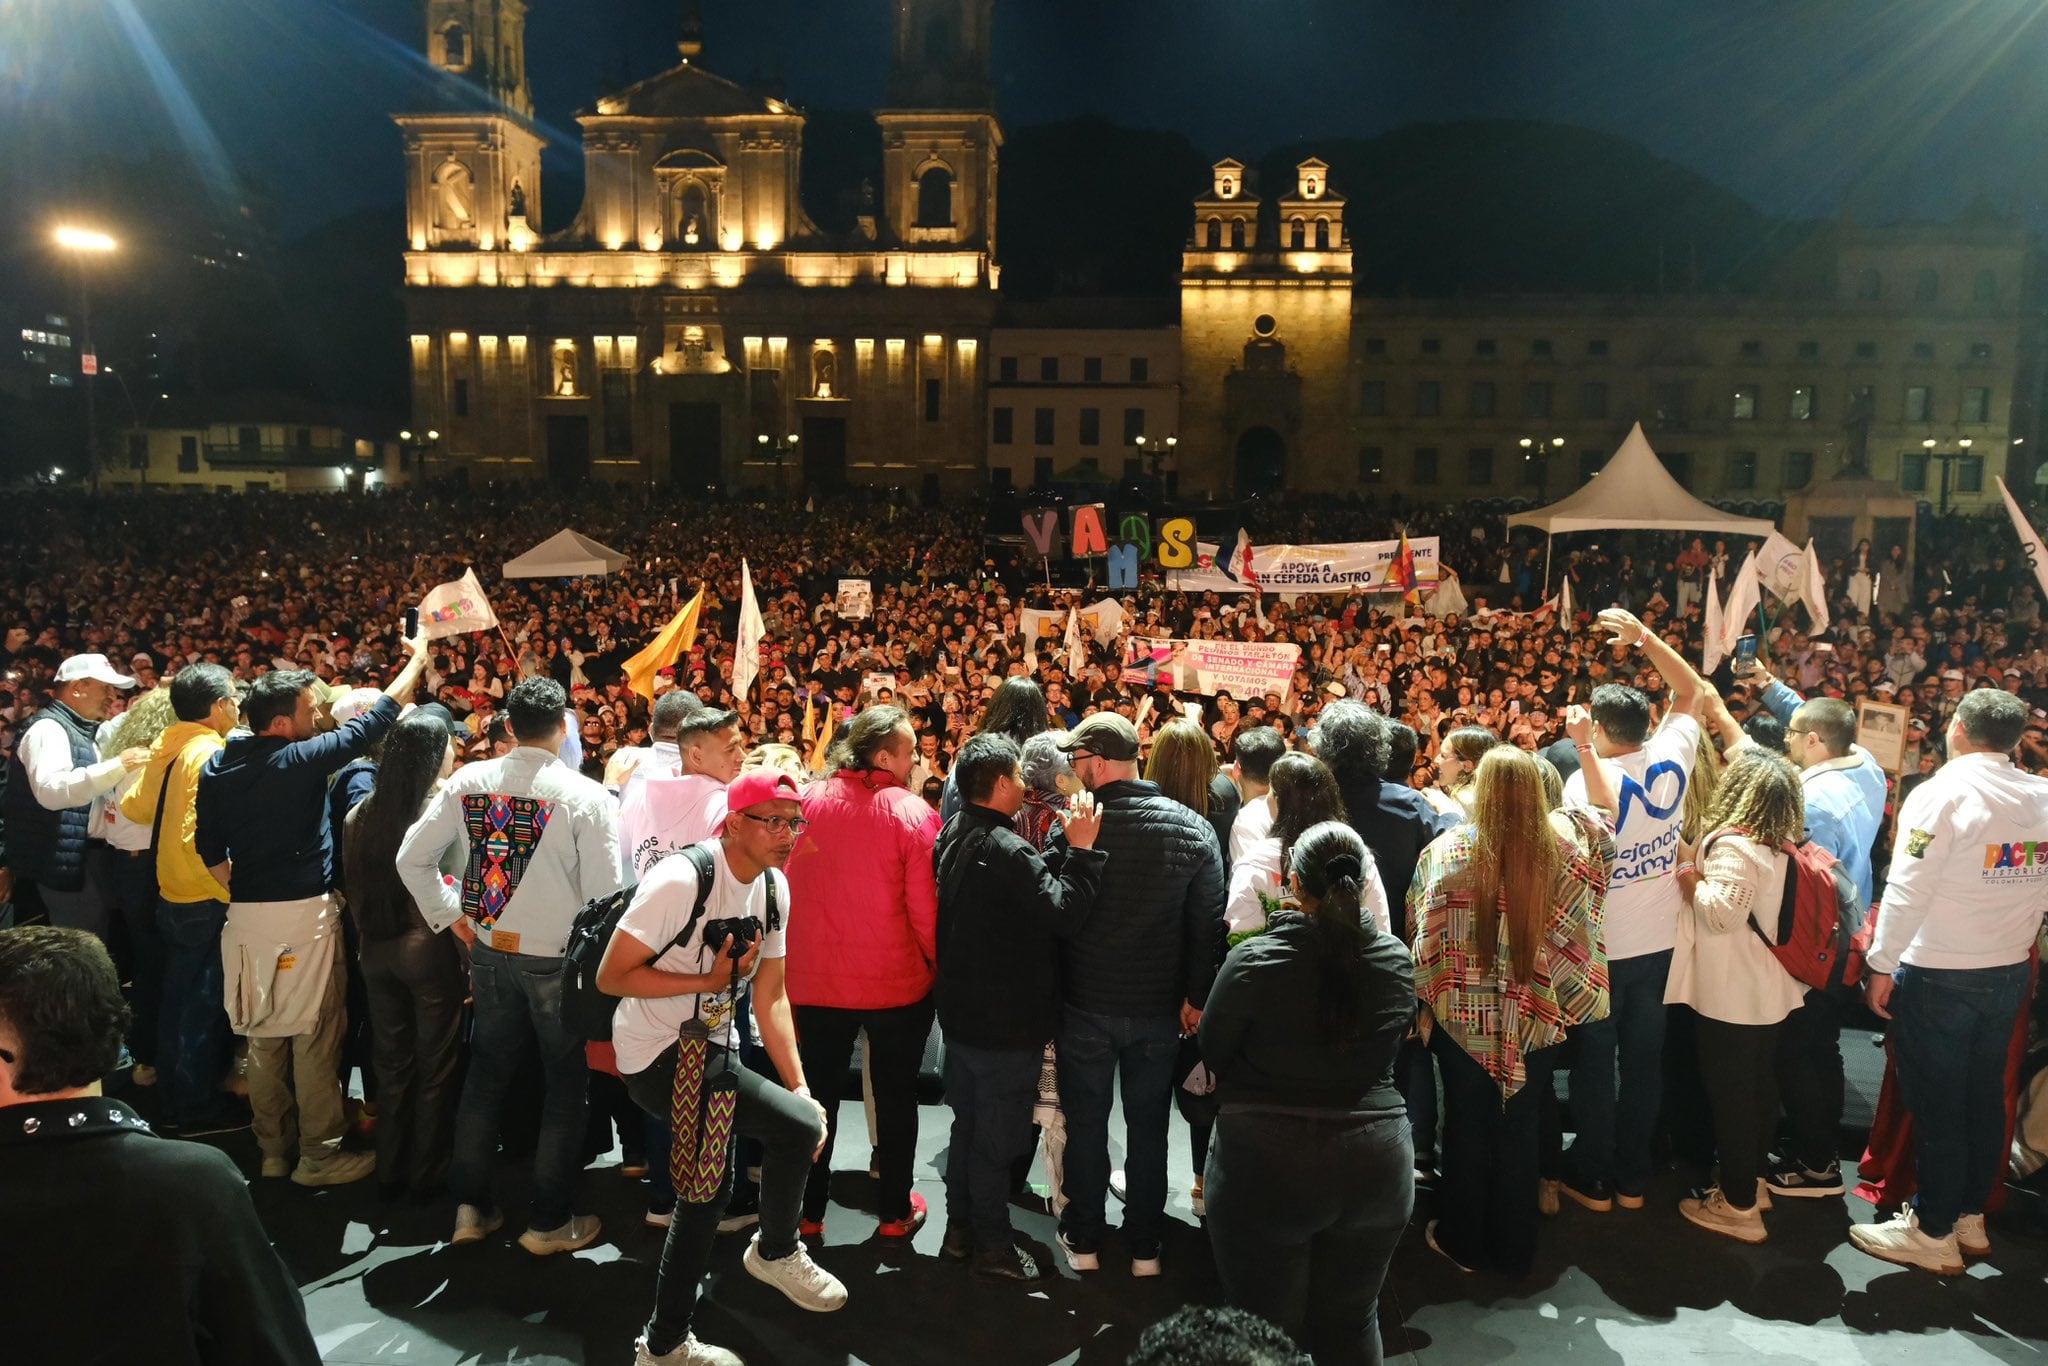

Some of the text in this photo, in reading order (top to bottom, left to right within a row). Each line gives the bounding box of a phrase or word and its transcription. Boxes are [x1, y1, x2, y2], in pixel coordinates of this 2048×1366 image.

[1280, 562, 1331, 574] APOYA A
[1274, 572, 1319, 584] CEPEDA
[1324, 571, 1371, 584] CASTRO
[1198, 645, 1240, 656] PEDIMOS
[1215, 643, 1227, 651] EN
[1243, 644, 1276, 652] MUNDO
[1191, 654, 1295, 671] DE SENADO Y CÁMARA
[1205, 664, 1279, 677] INTERNACIONAL
[1222, 674, 1268, 685] VOTAMOS
[634, 836, 659, 870] SOMOS
